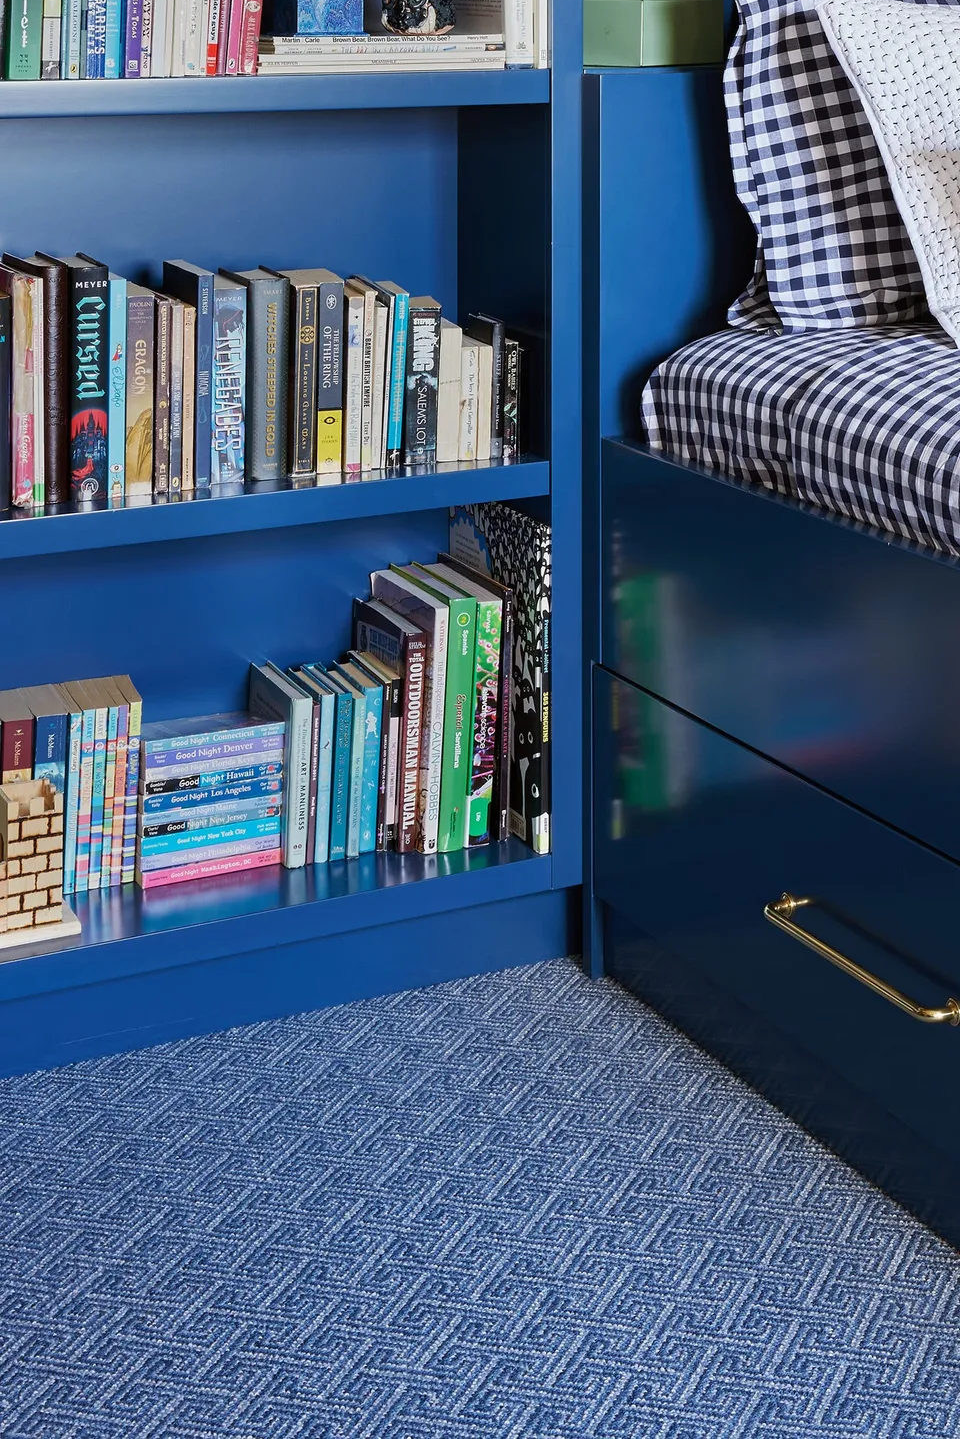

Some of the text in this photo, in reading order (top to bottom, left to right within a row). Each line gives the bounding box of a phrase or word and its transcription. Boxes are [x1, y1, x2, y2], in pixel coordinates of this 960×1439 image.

[142, 16, 151, 38] DAY
[75, 281, 107, 289] MEYER
[75, 296, 106, 401] Cursed
[323, 326, 330, 343] OF
[413, 326, 436, 371] KING
[135, 339, 147, 395] ERAGON
[198, 370, 209, 398] NIMONA
[265, 302, 277, 457] WITCHES STEEPED IN GOLD
[302, 363, 310, 398] LOOKING
[322, 362, 330, 388] RING
[215, 336, 242, 452] RENEGADES
[417, 385, 427, 445] 'SALEM'S LOT
[461, 630, 469, 655] Spanish
[47, 734, 55, 758] McMann
[176, 743, 254, 760] Good Night Denver
[402, 663, 423, 830] OUTDOORSMAN MANUAL
[453, 732, 462, 768] Santillana
[179, 769, 254, 788] Good Night Hawaii
[429, 722, 443, 821] CALVIN HOBBES
[298, 785, 306, 831] MANLINESS
